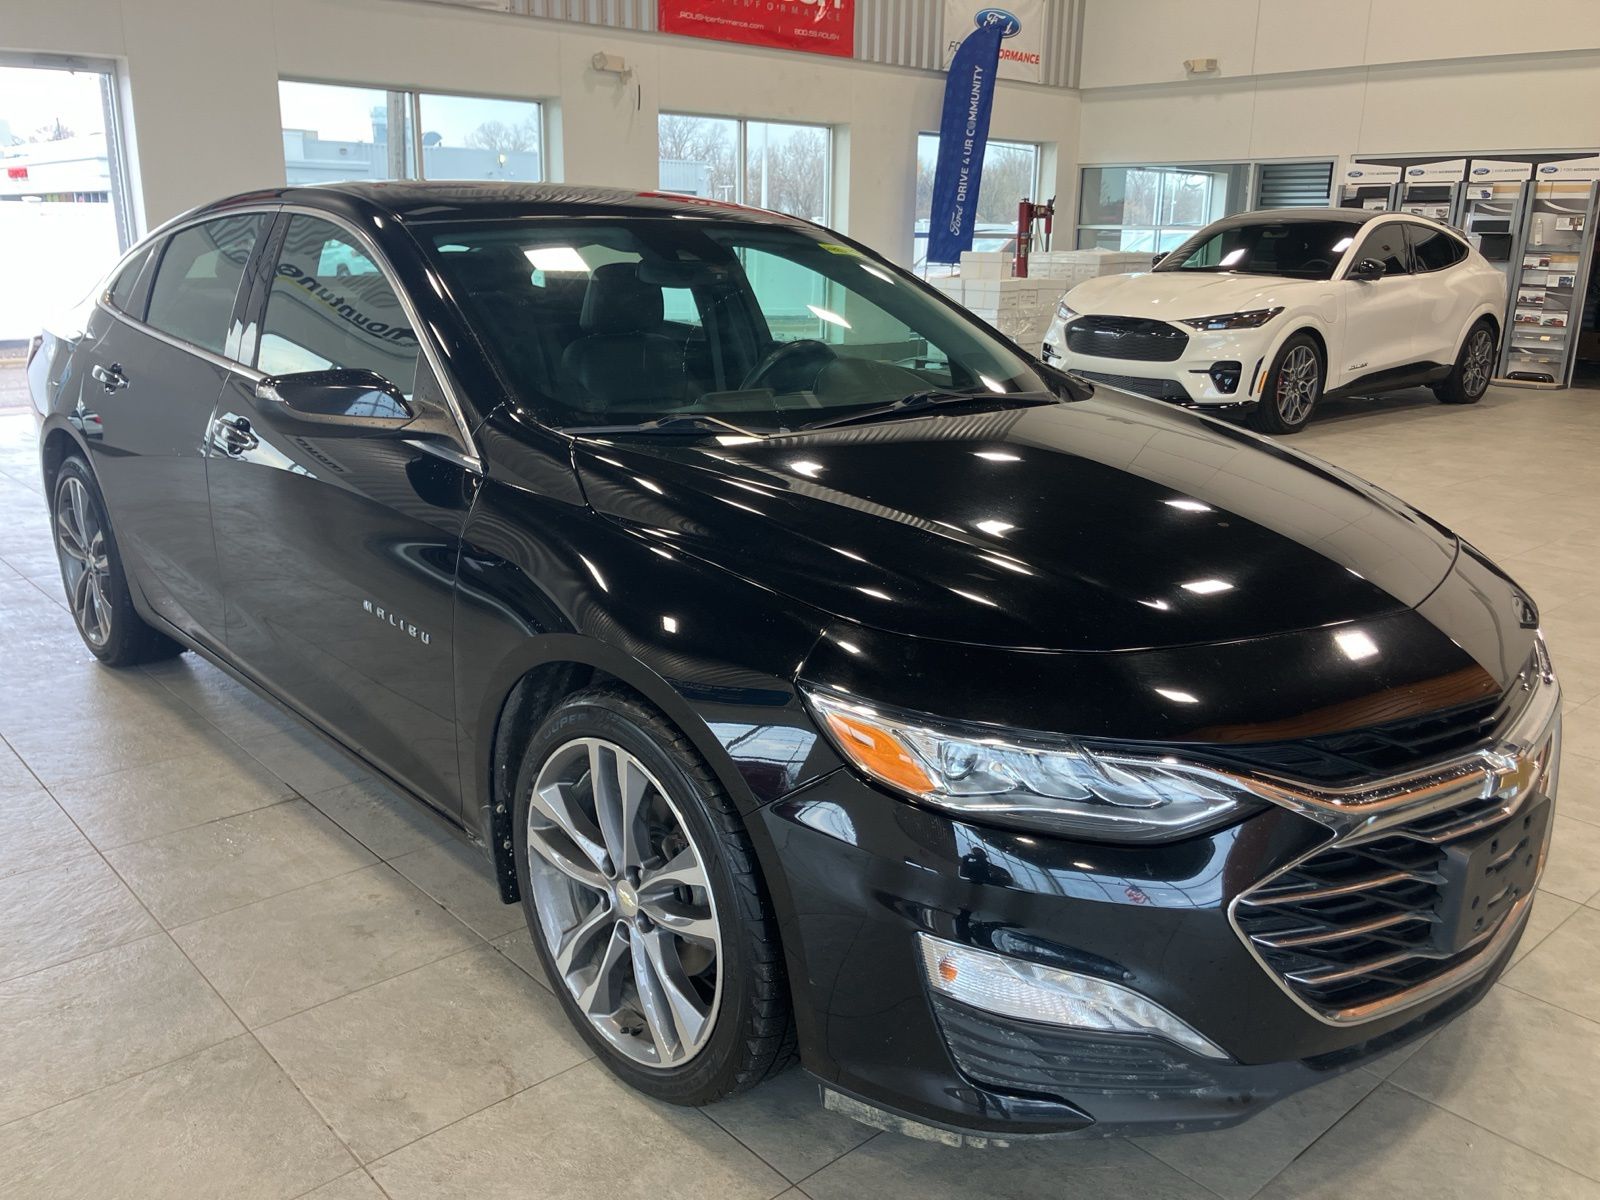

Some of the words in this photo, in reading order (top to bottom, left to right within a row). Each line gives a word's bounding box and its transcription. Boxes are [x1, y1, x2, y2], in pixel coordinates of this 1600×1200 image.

[998, 48, 1041, 65] ORMANCE
[966, 65, 984, 136] COMMUNITY
[962, 156, 971, 165] 4
[963, 139, 974, 155] UR
[957, 168, 969, 202] DRIVE
[949, 205, 964, 236] Ford
[362, 599, 430, 645] MALIBU
